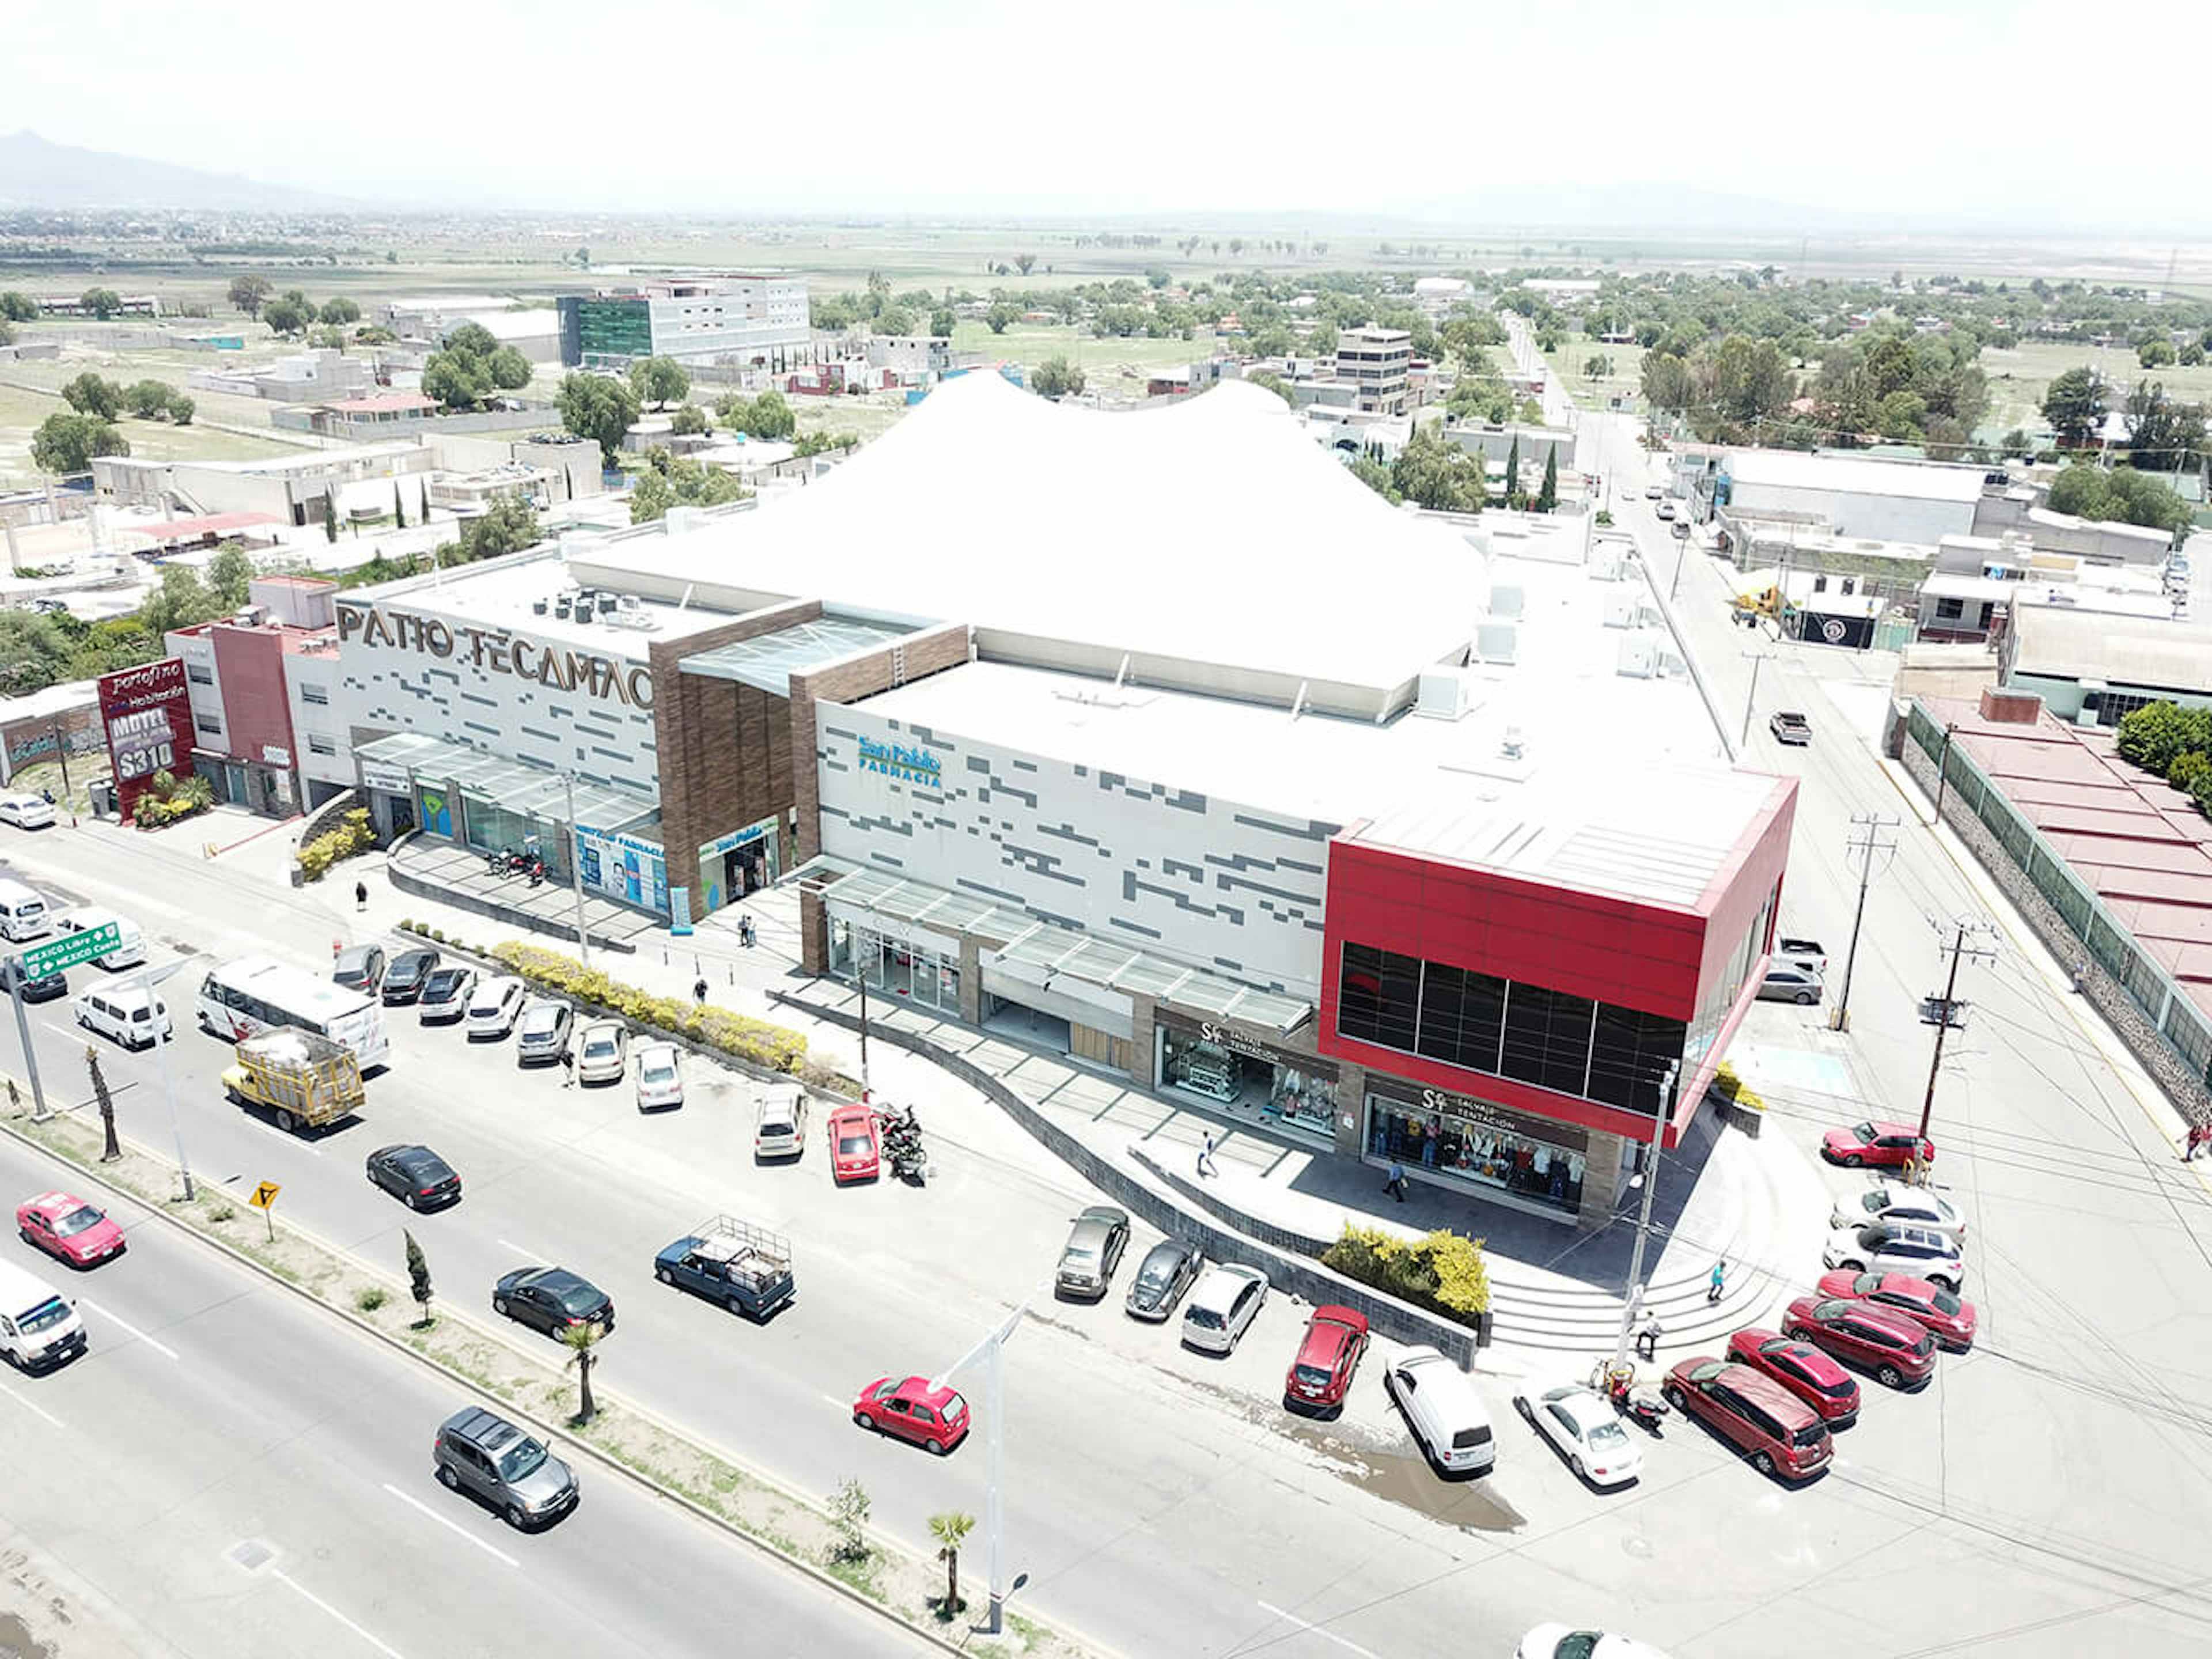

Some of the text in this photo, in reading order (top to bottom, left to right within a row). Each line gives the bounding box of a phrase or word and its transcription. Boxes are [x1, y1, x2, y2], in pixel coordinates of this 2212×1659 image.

[336, 606, 453, 658] PATIO
[113, 707, 167, 737] MOTEL
[858, 758, 941, 788] FARMACIA
